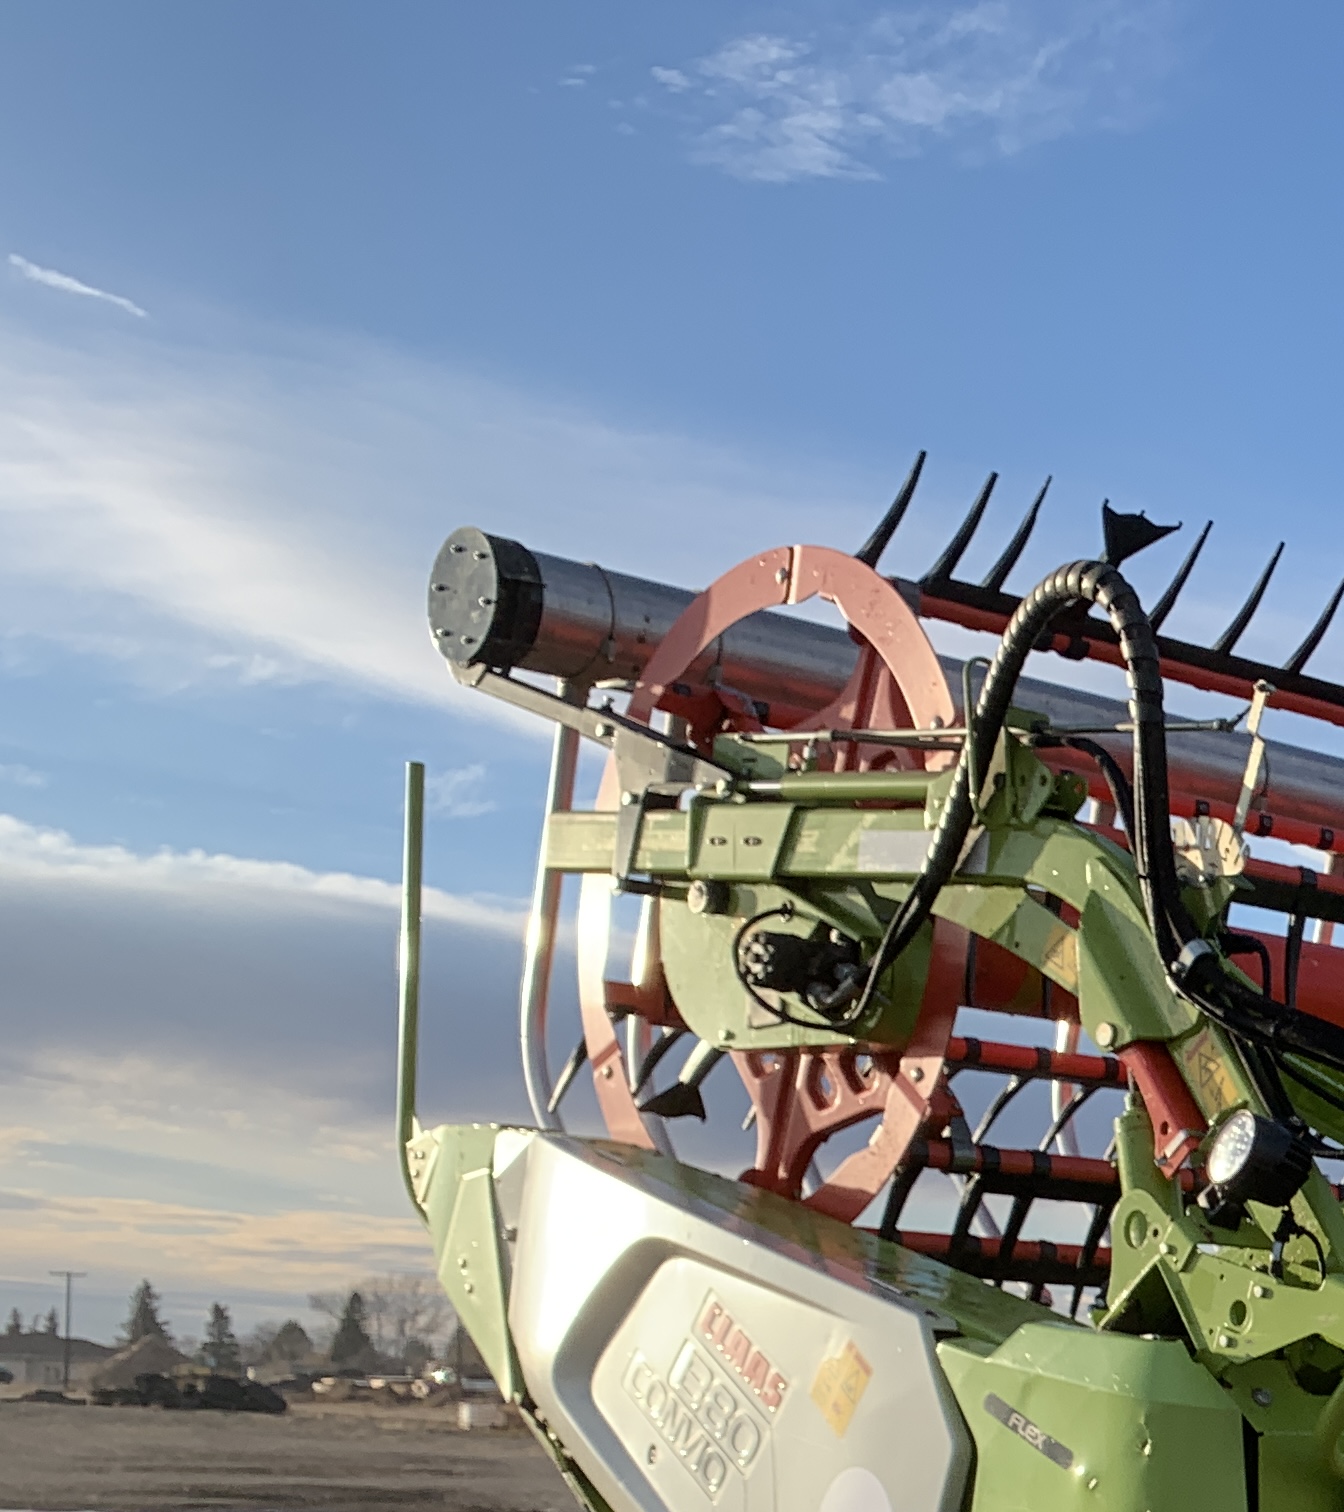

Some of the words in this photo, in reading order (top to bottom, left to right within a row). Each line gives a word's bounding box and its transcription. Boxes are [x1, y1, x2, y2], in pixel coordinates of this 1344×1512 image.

[701, 1302, 789, 1412] CLAAS
[629, 1357, 727, 1492] CONVIO
[1008, 1412, 1046, 1450] FLEX
